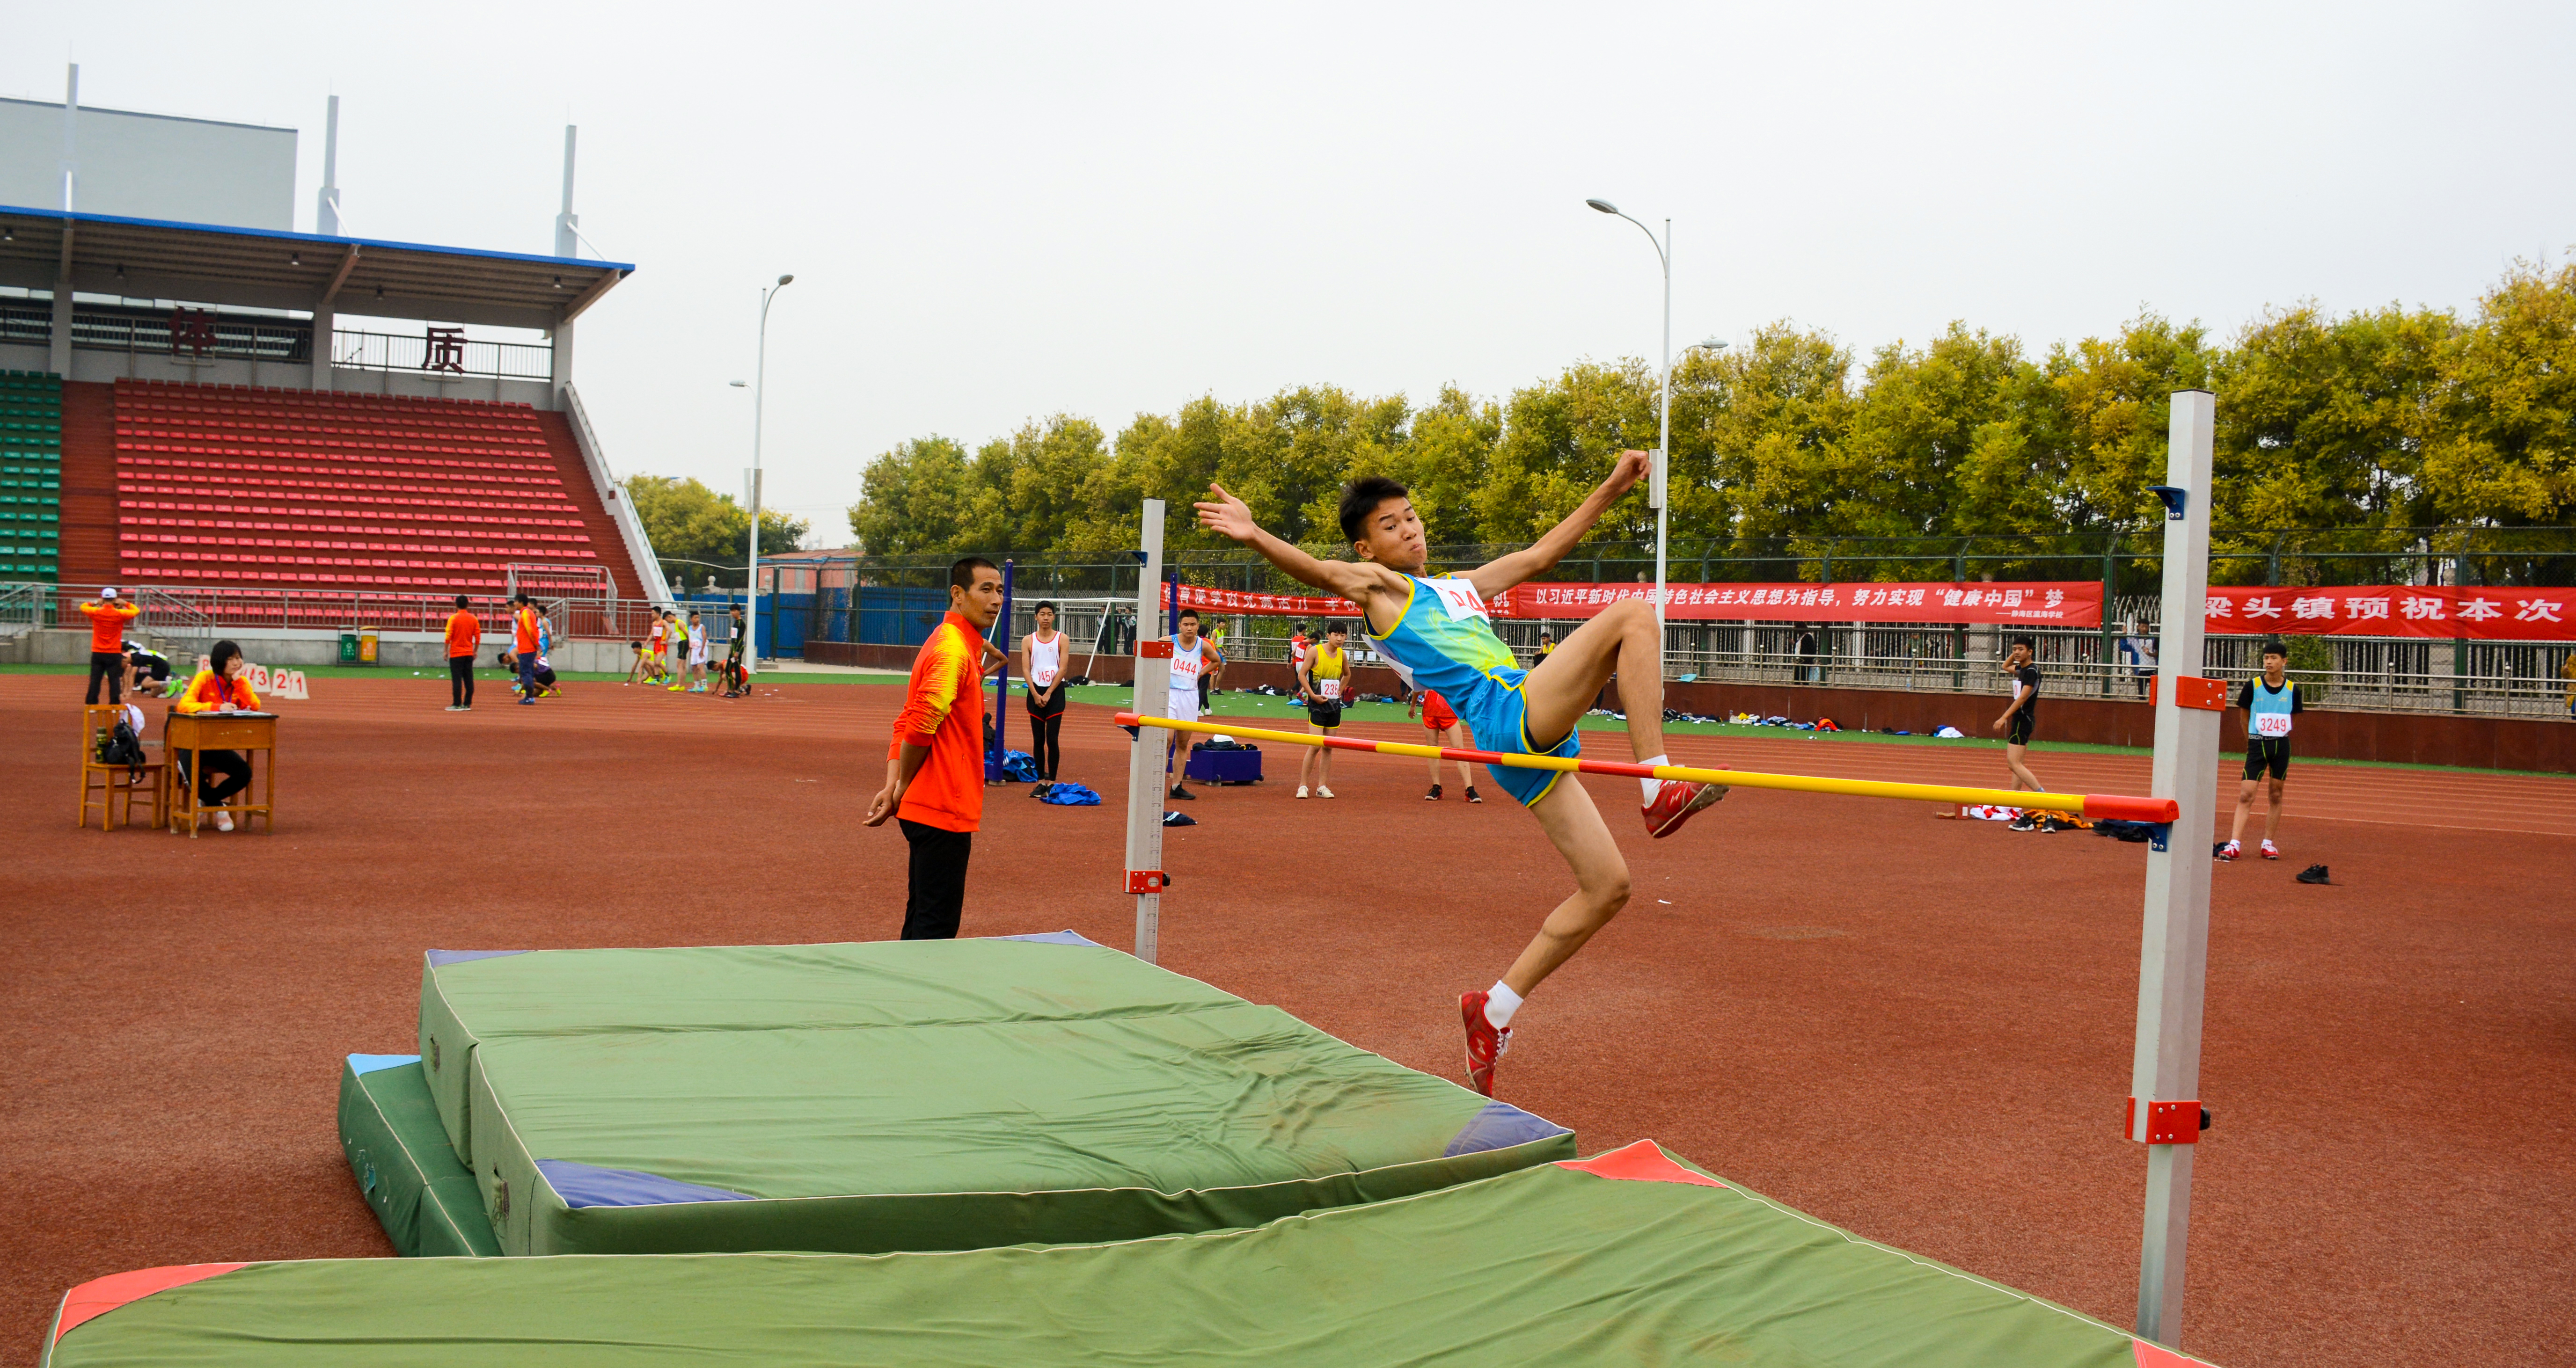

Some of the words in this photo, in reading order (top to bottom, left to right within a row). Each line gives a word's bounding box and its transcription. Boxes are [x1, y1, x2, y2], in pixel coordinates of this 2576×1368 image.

[168, 306, 218, 355] 体
[423, 327, 467, 374] 质
[2205, 597, 2563, 623] 梁头镇预祝本次
[1173, 658, 1197, 675] 0444
[258, 671, 267, 685] 3
[277, 674, 286, 689] 2
[297, 677, 302, 692] 1
[2260, 718, 2286, 732] 3249
